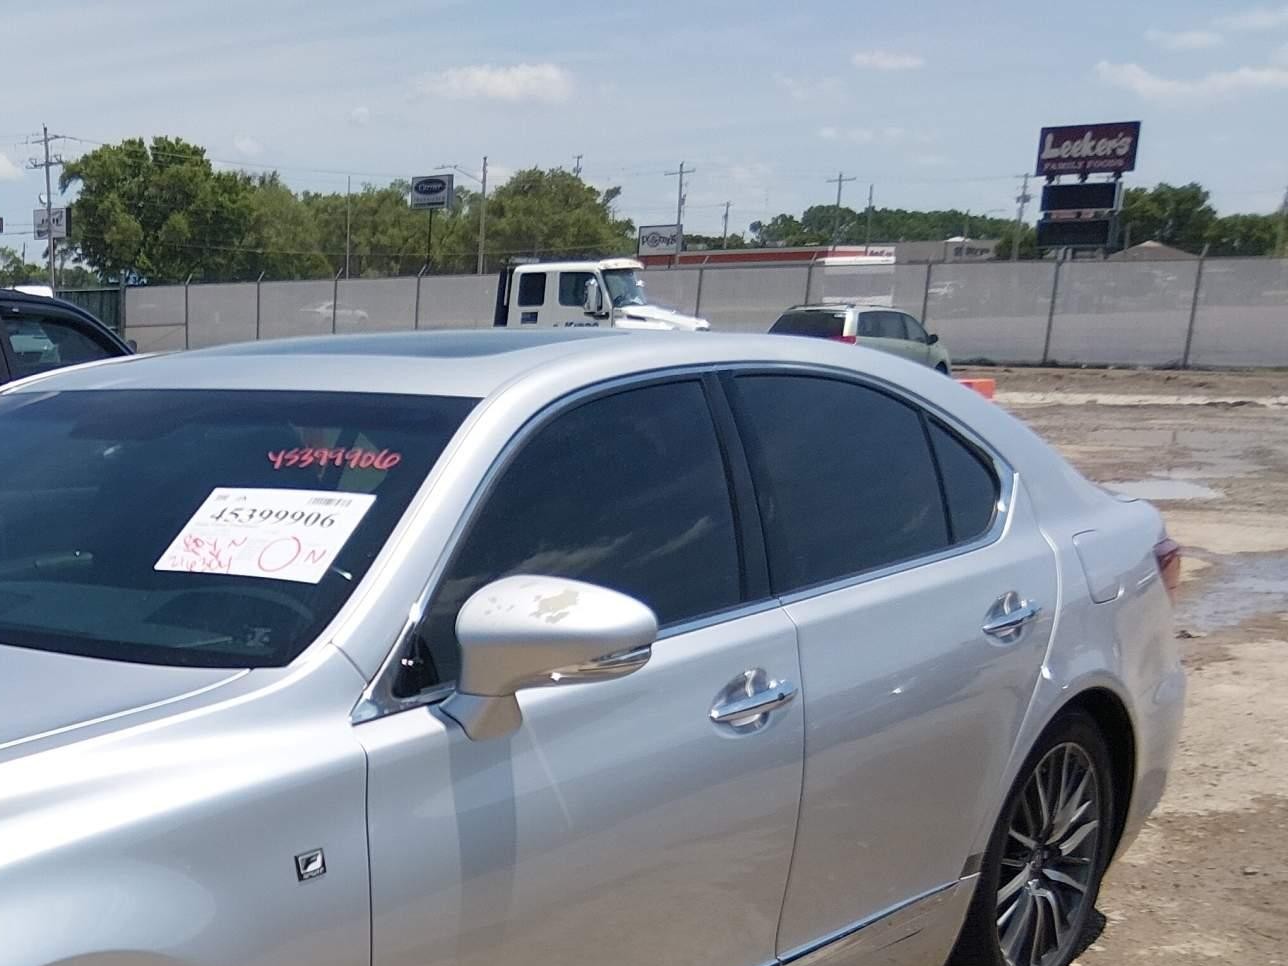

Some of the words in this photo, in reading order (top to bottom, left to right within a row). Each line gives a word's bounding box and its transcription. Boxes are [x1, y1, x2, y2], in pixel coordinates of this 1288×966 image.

[1042, 131, 1133, 159] Leeker's
[268, 447, 402, 470] 45399906
[211, 506, 337, 529] 45399906
